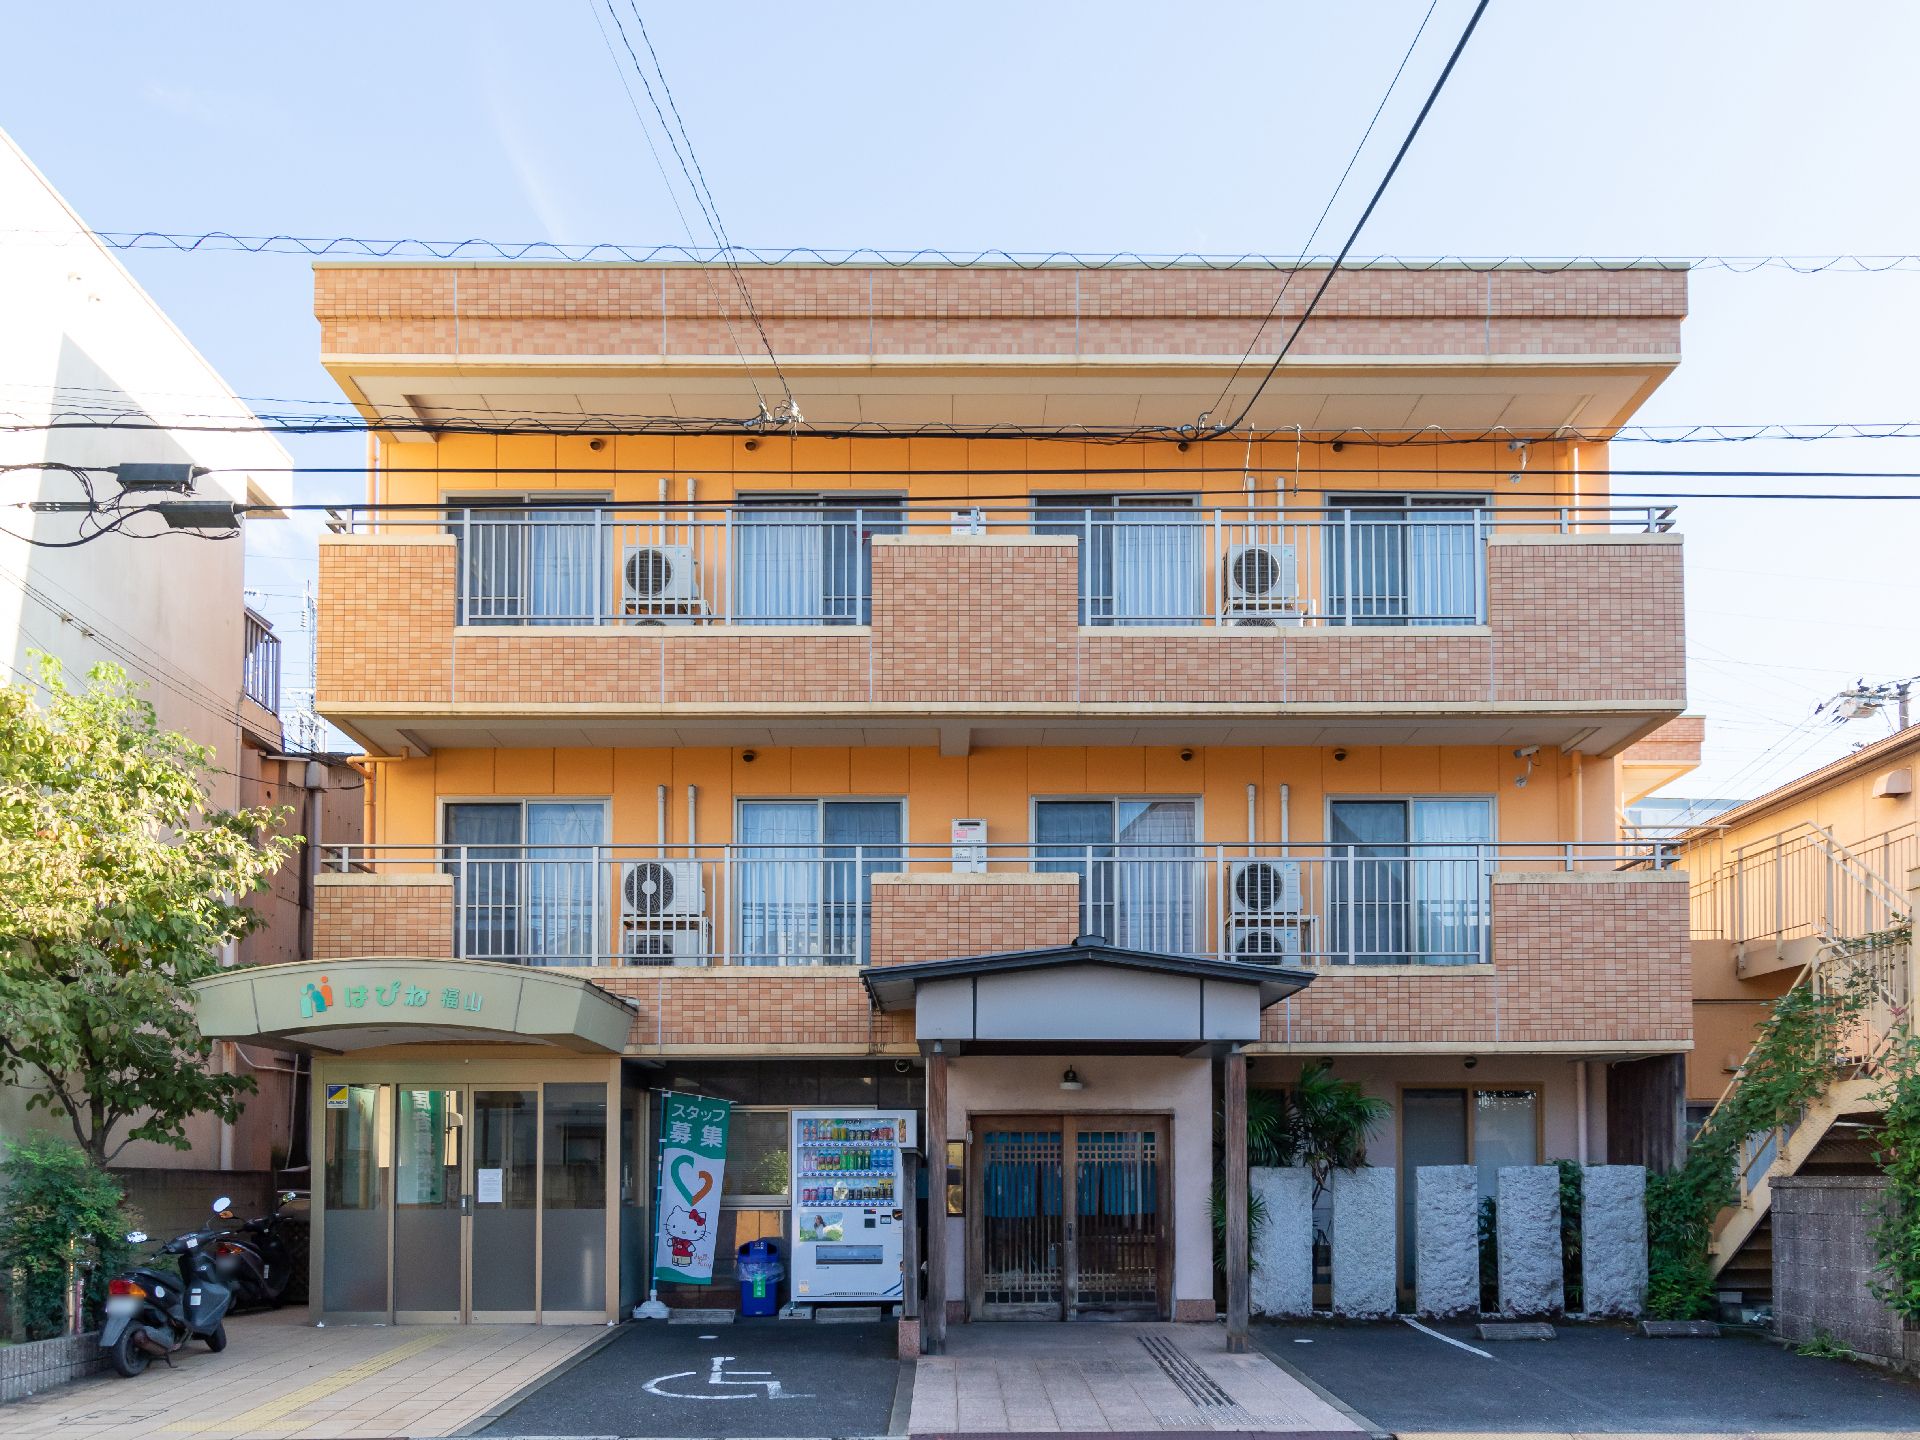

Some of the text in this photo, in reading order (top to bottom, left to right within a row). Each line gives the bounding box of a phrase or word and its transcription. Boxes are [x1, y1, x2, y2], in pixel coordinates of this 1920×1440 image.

[344, 980, 482, 1012] はぴね 福山
[671, 1103, 725, 1122] スタッフ
[670, 1121, 722, 1148] 募集
